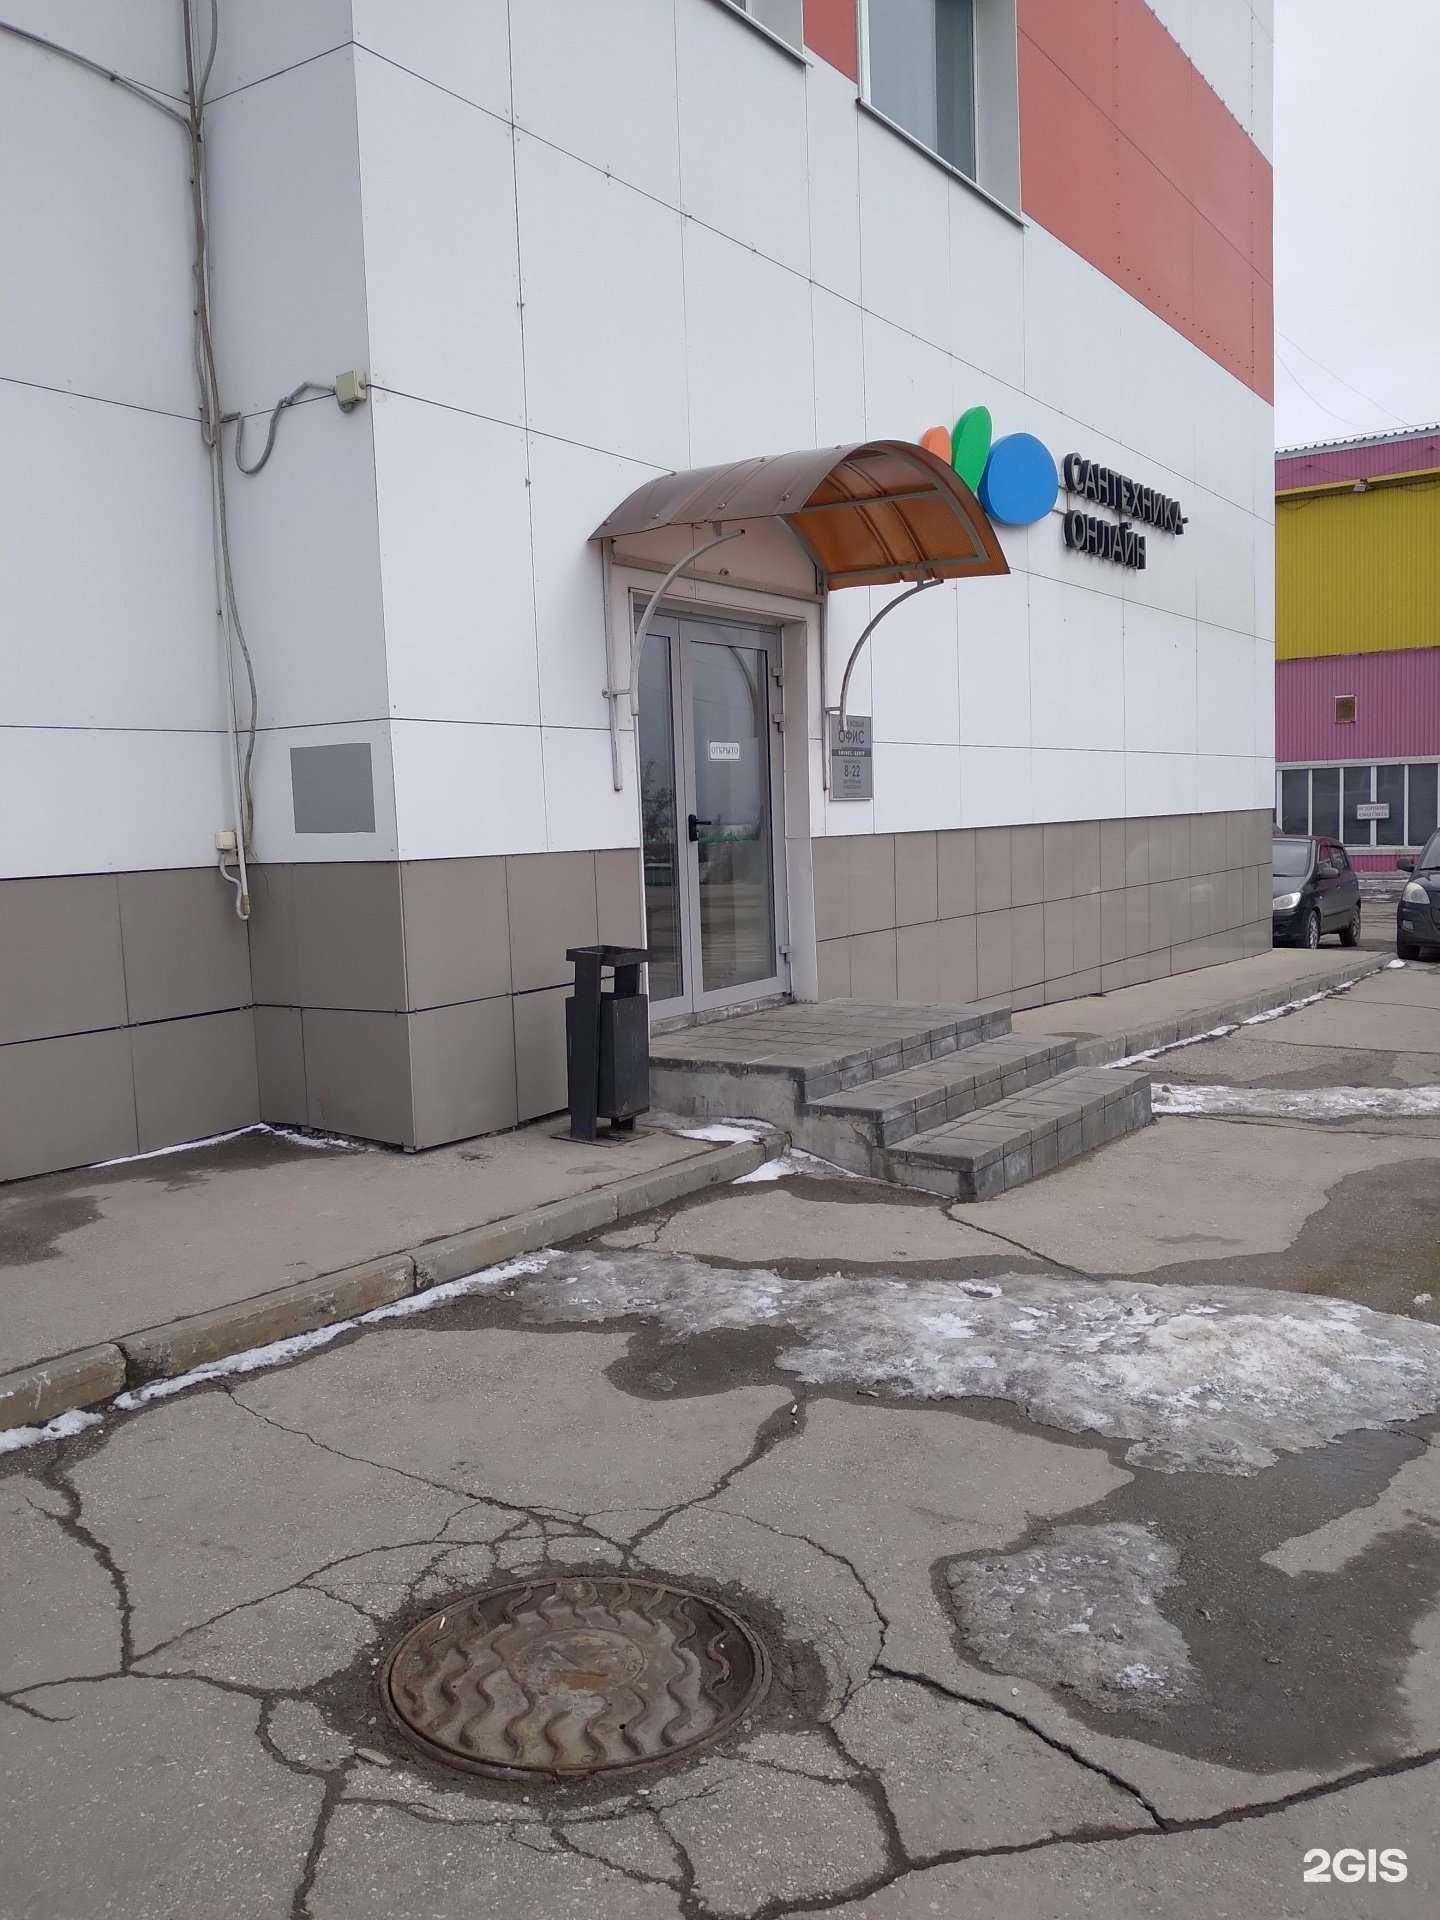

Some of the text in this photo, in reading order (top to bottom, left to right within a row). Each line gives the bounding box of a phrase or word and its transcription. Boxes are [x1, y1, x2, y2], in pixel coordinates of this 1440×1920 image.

[1063, 452, 1189, 535] САНТЕХНИКА-
[1062, 510, 1147, 569] ОНЛАЙН
[838, 730, 865, 744] ОФИС
